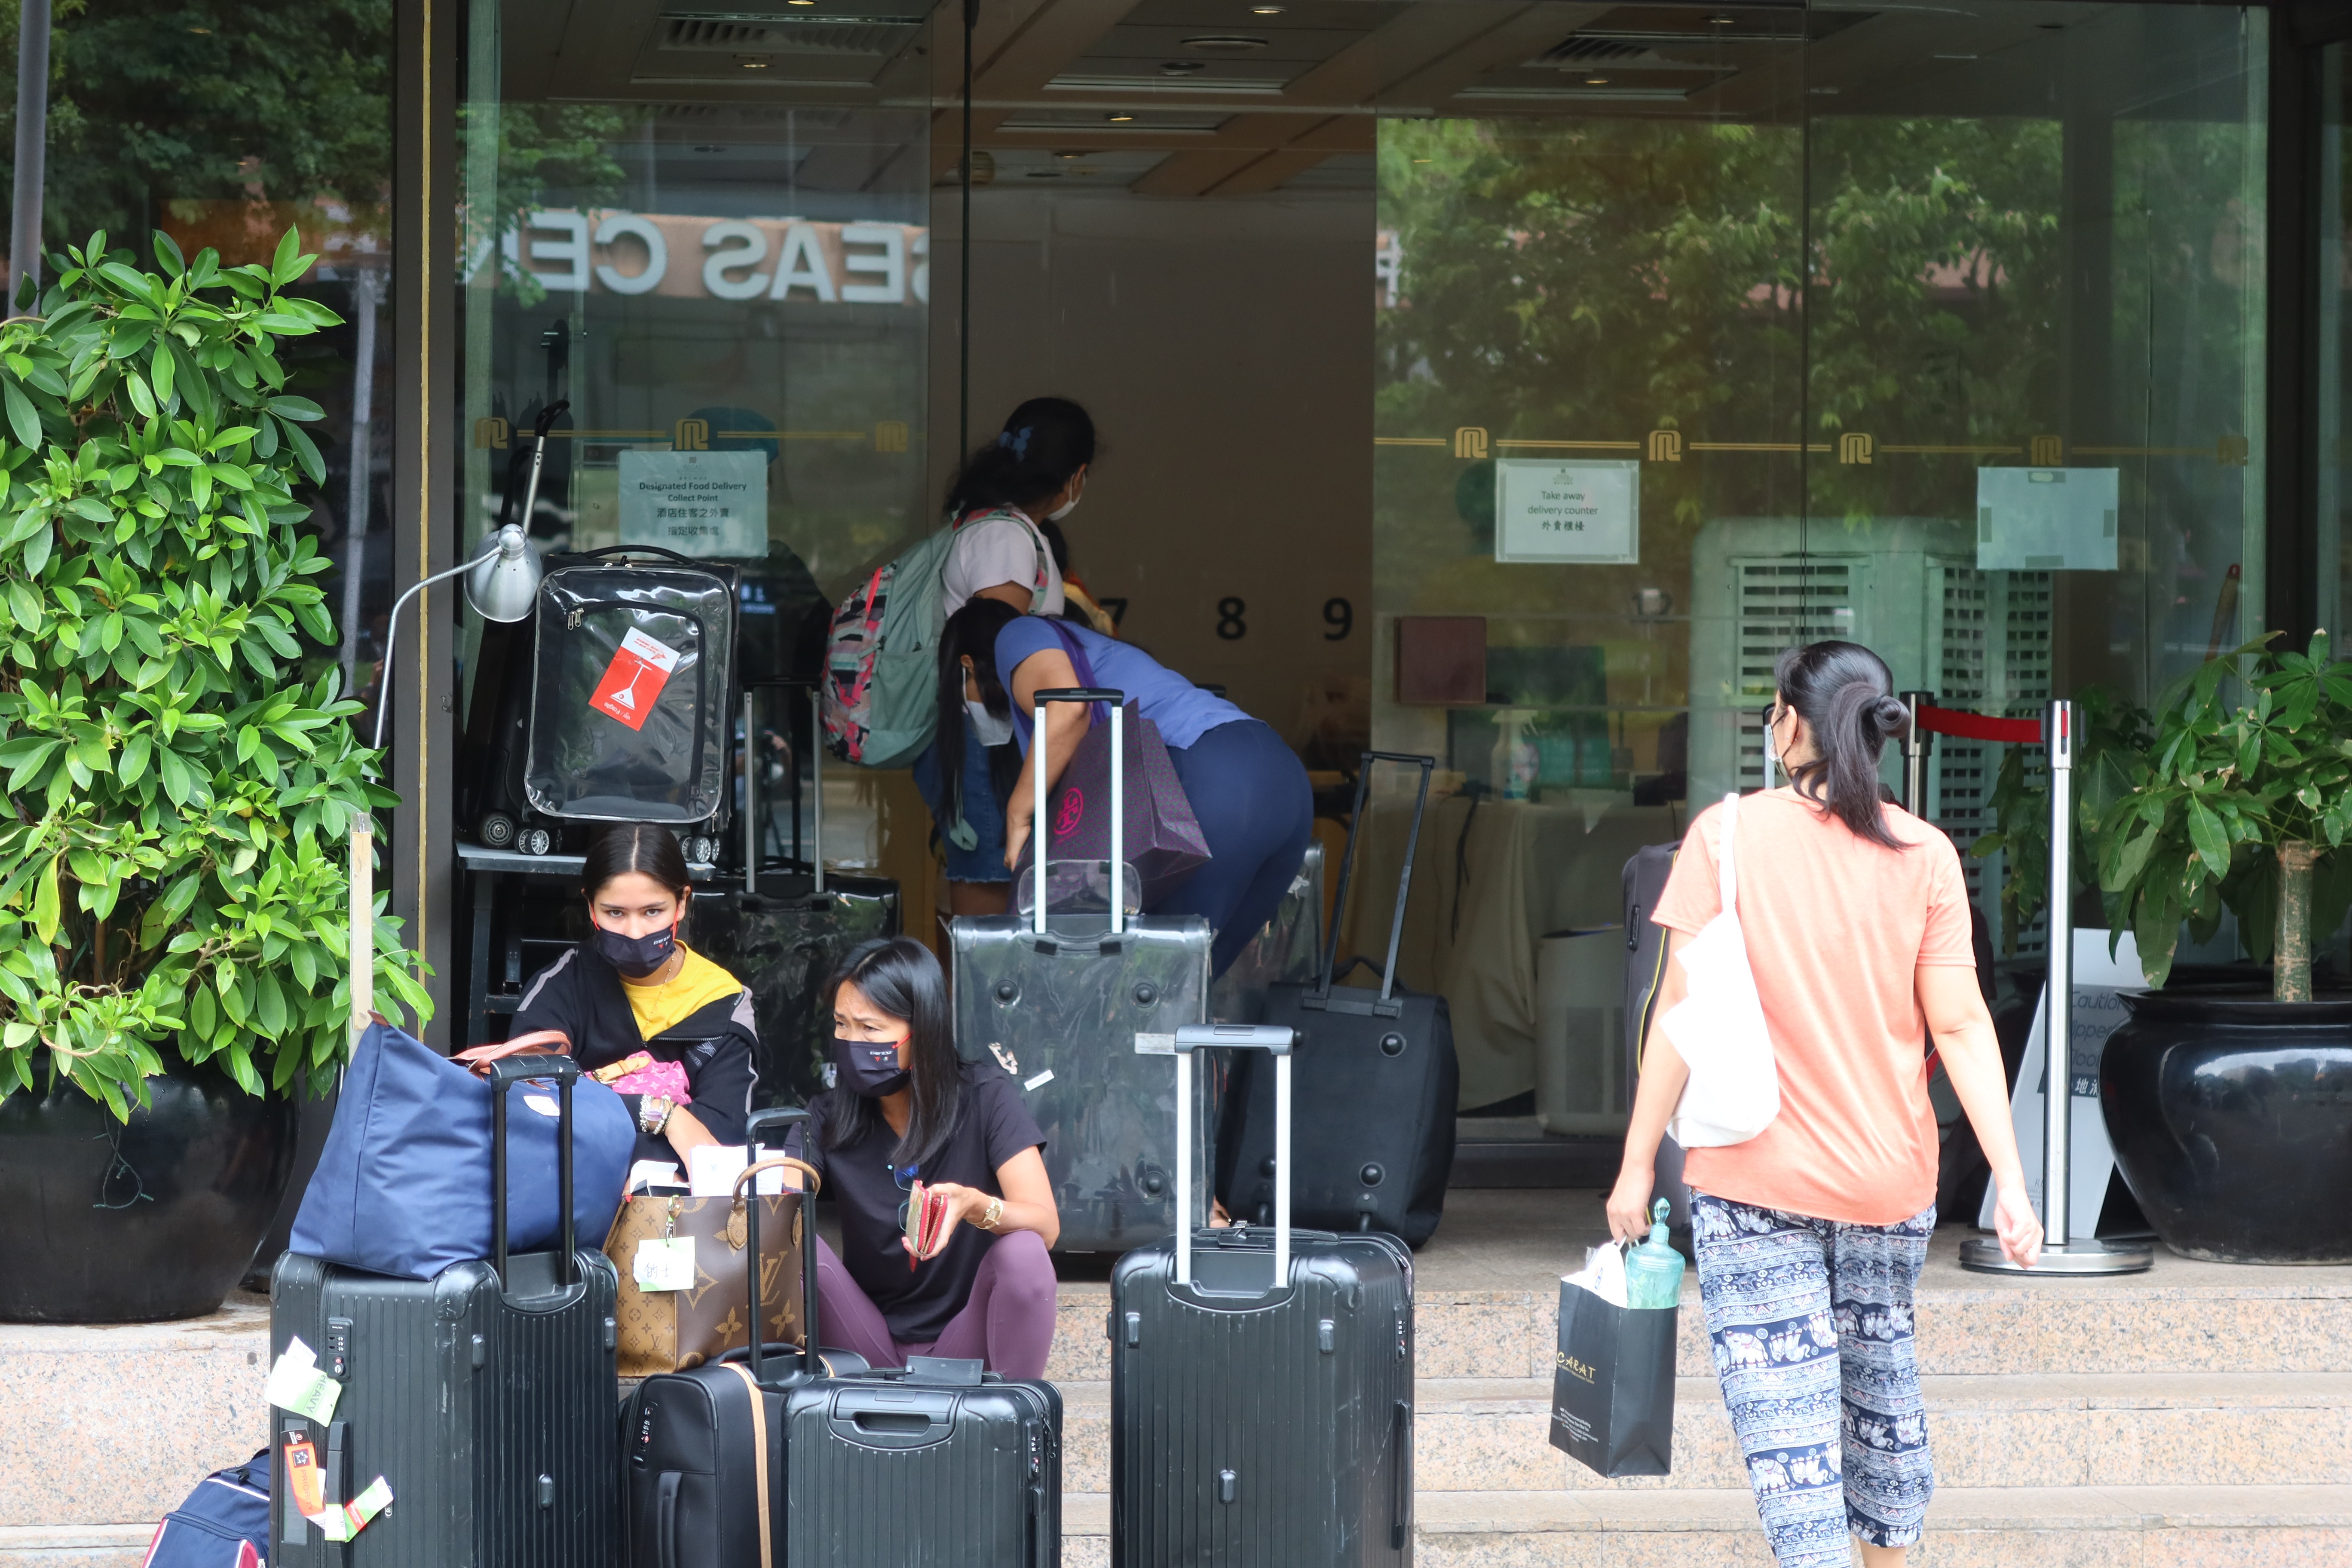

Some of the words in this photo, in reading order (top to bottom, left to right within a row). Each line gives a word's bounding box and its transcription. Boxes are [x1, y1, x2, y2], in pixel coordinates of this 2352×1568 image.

[640, 482, 686, 491] Designated
[712, 482, 747, 491] Delivery
[1541, 491, 1561, 500] Take
[1563, 493, 1585, 502] away
[1528, 505, 1562, 515] delivery
[1216, 597, 1246, 640] 8
[1323, 597, 1353, 640] 9
[604, 701, 621, 715] Fragile
[2072, 990, 2119, 1010] Cautio
[644, 1262, 671, 1280] 的士
[1556, 1351, 1597, 1379] CARAT
[306, 1374, 328, 1414] HEAVY
[300, 1469, 313, 1511] PRIORITY
